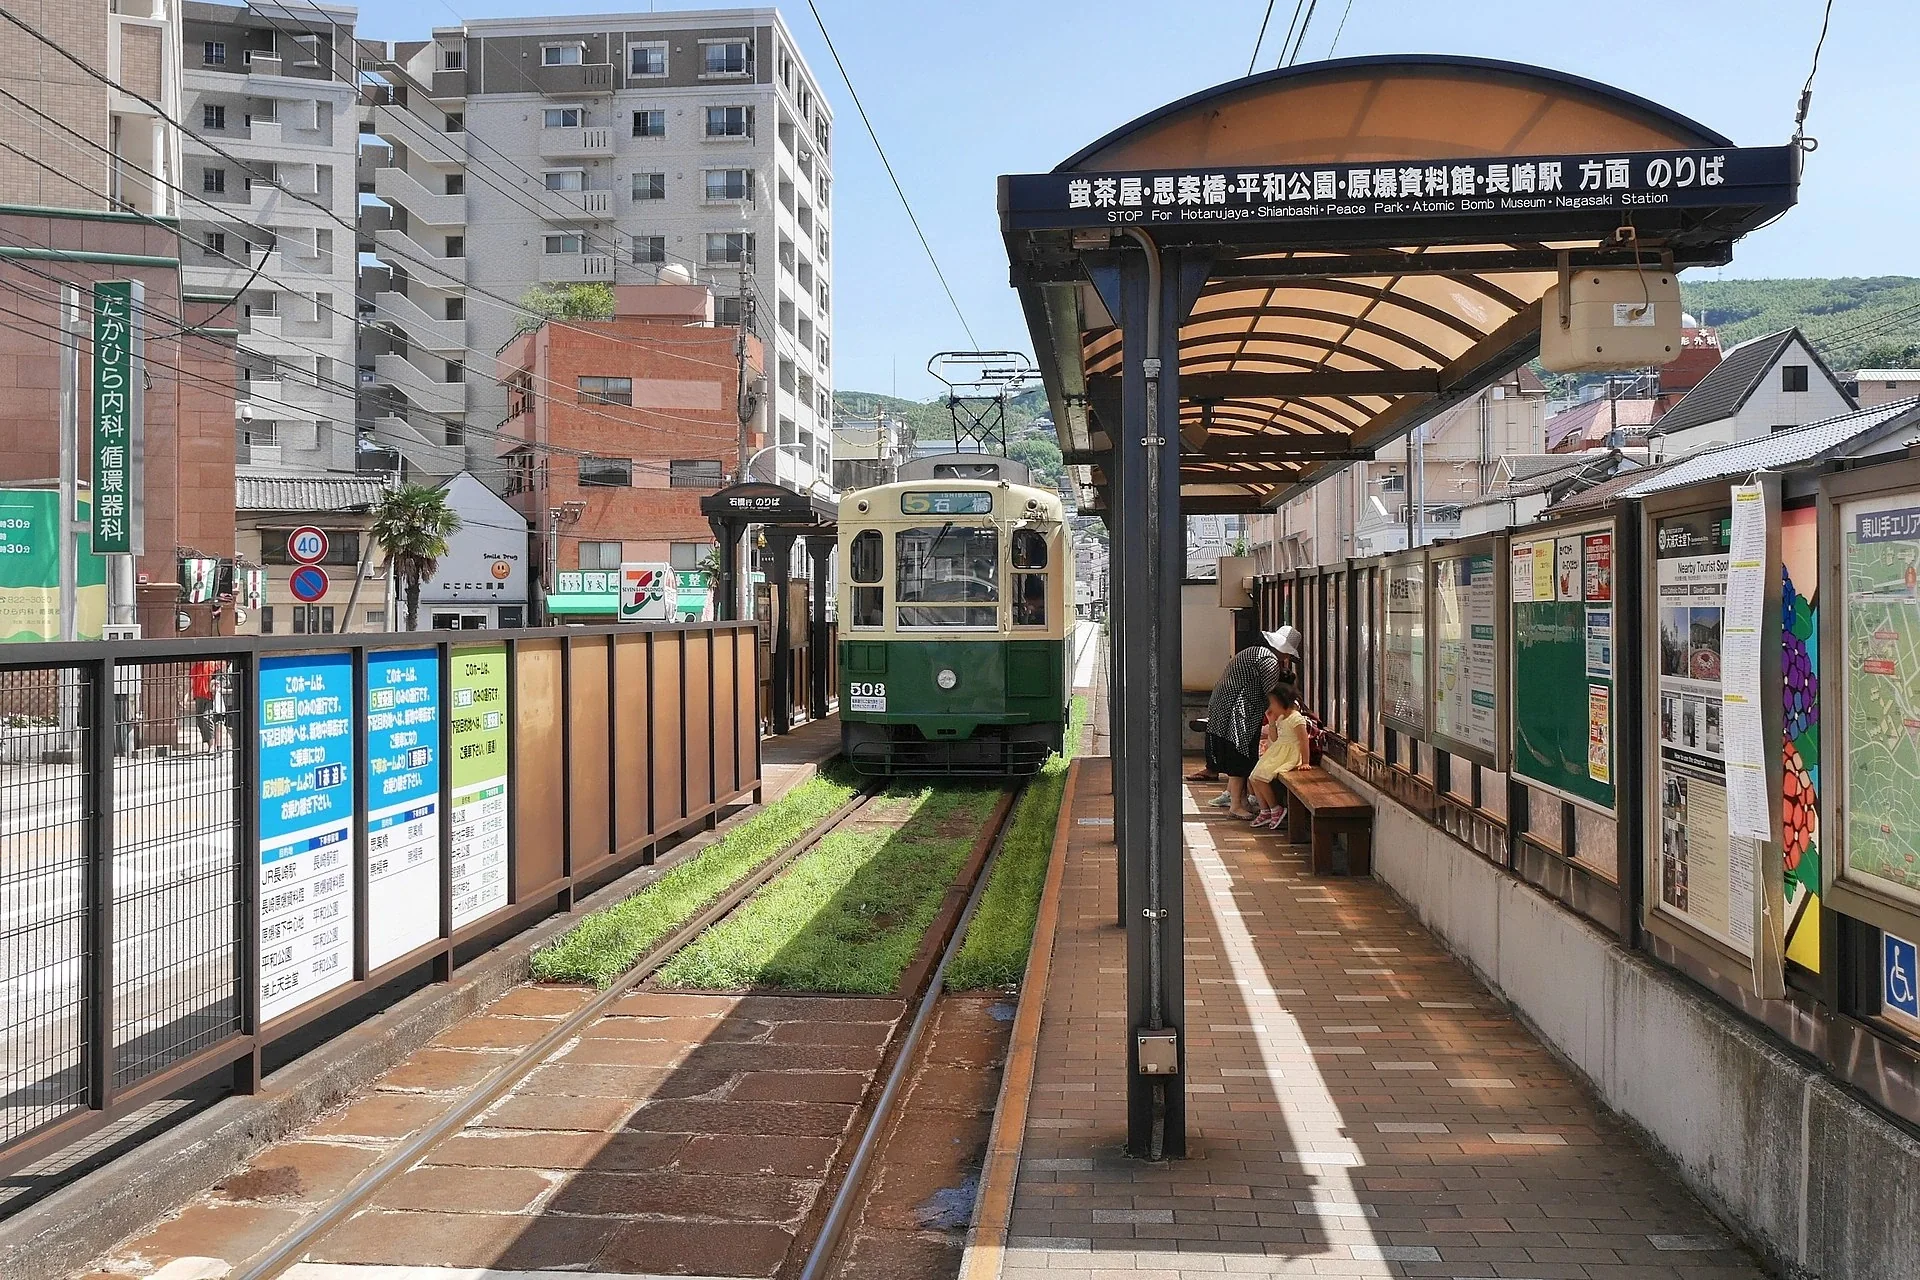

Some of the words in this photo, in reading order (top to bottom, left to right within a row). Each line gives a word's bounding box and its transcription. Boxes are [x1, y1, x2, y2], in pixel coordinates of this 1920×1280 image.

[1579, 158, 1630, 190] 方面
[1646, 155, 1725, 188] のりば
[1107, 210, 1143, 222] STOP
[1151, 209, 1173, 221] For
[1461, 199, 1495, 211] Bomb
[1621, 192, 1669, 205] Station
[755, 497, 780, 507] のりば
[904, 493, 930, 513] 5
[298, 537, 319, 554] 40
[502, 553, 518, 561] Drug
[1717, 559, 1729, 572] Spot
